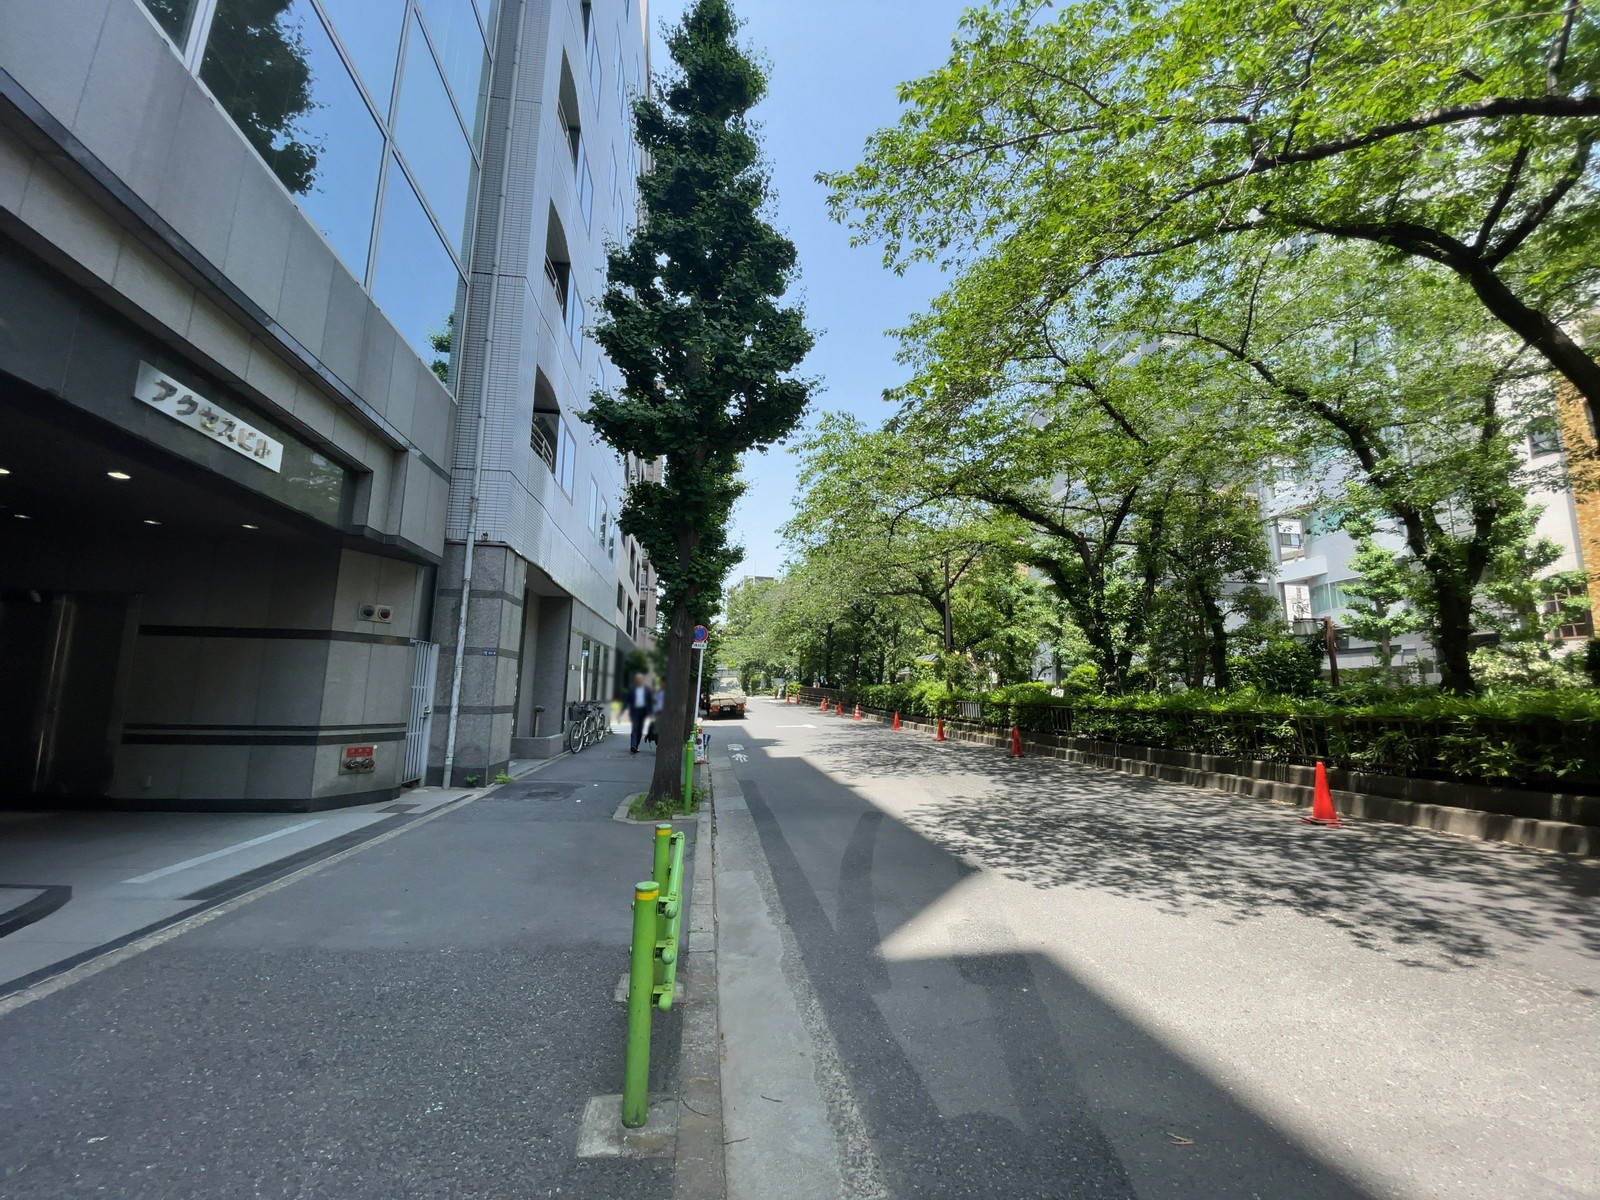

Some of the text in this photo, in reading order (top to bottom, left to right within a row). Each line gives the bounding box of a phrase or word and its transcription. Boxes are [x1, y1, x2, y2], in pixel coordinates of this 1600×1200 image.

[152, 380, 271, 459] アクセスビル
